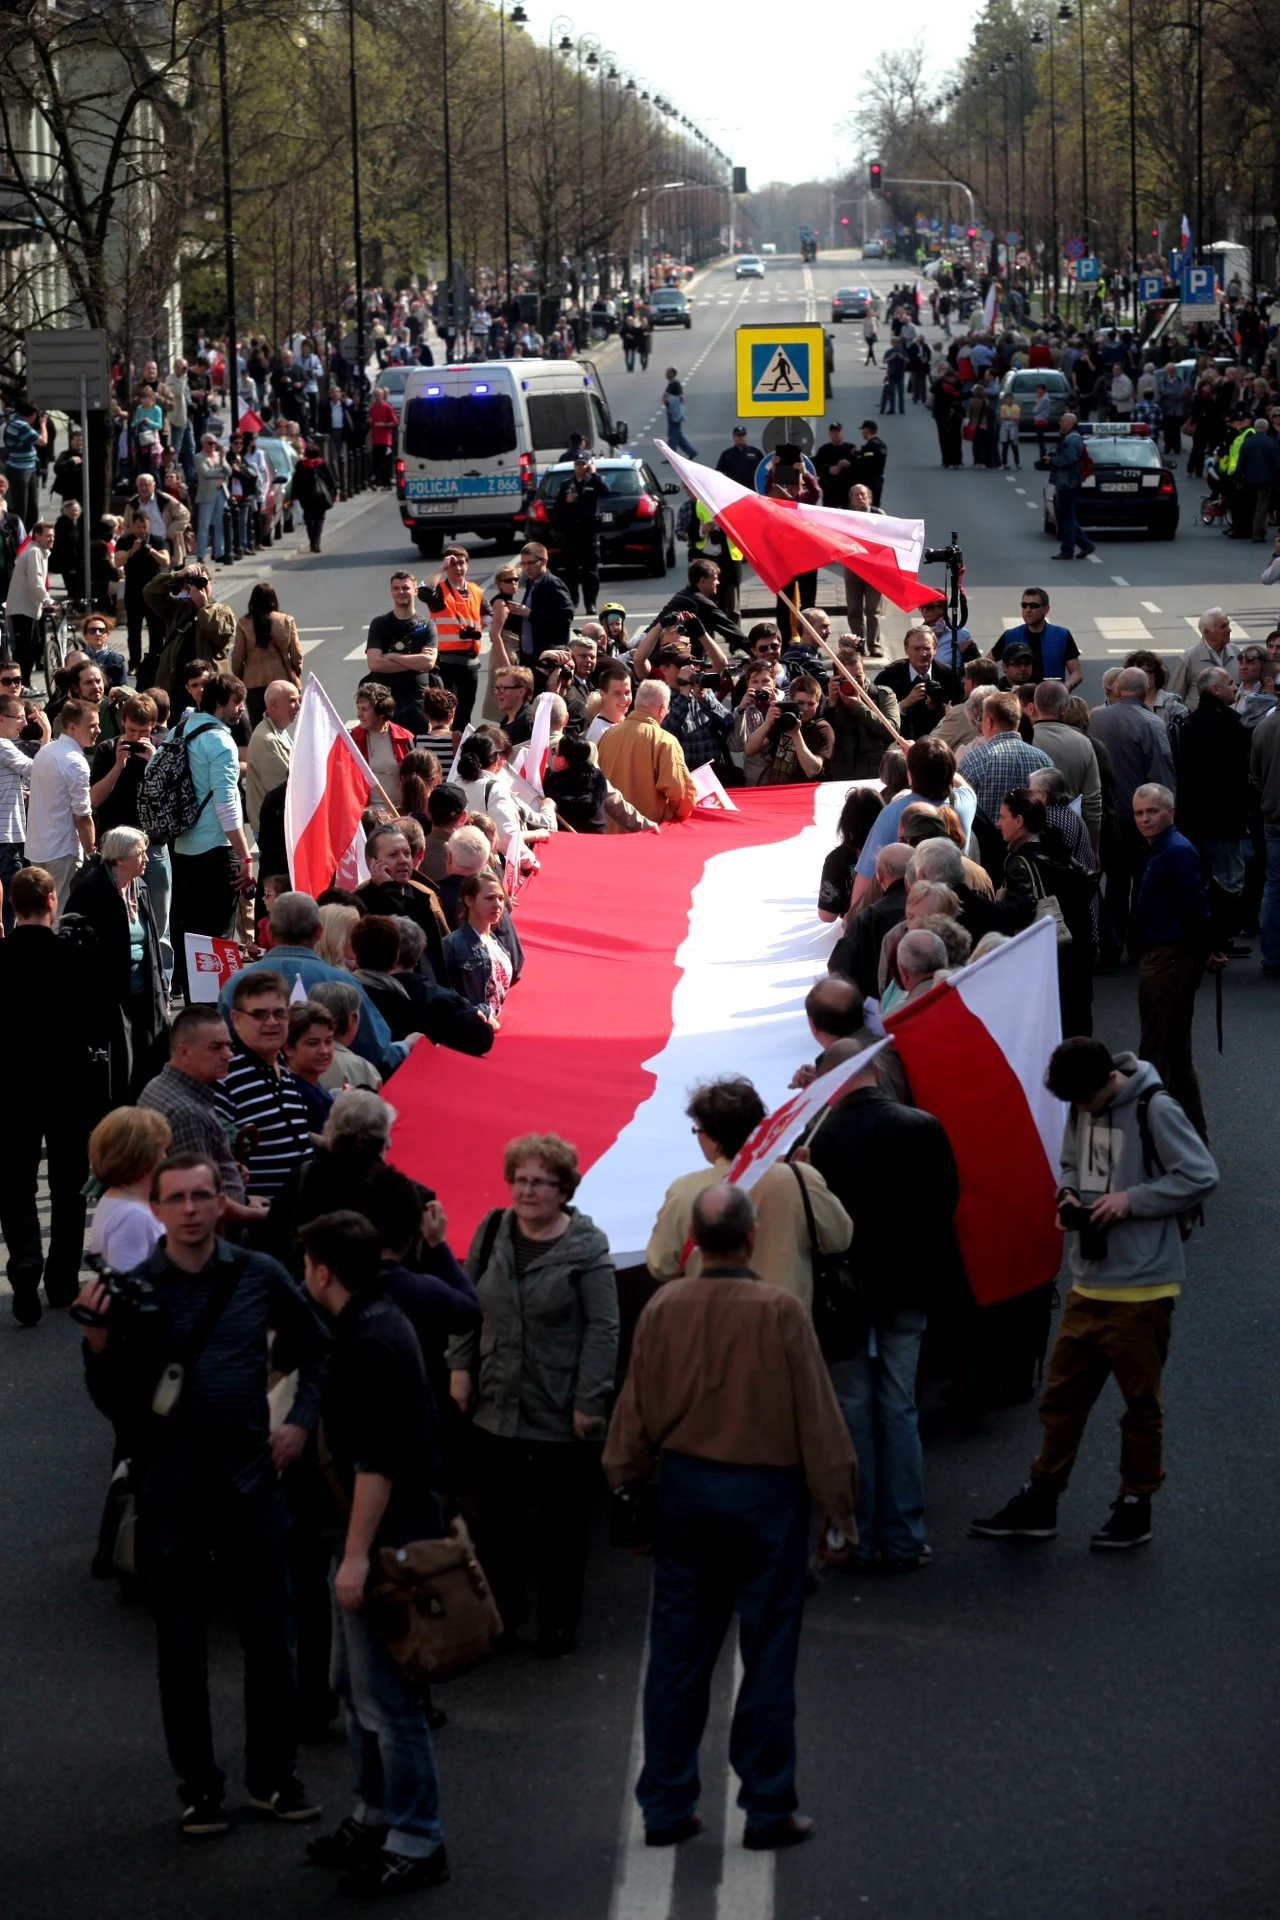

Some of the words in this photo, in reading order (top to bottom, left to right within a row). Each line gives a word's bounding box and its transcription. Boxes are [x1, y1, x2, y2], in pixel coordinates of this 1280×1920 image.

[1081, 260, 1094, 277] P
[1145, 279, 1159, 298] P
[1190, 269, 1207, 293] P
[408, 480, 459, 494] POLICJA
[488, 479, 495, 491] Z
[498, 477, 519, 490] 866
